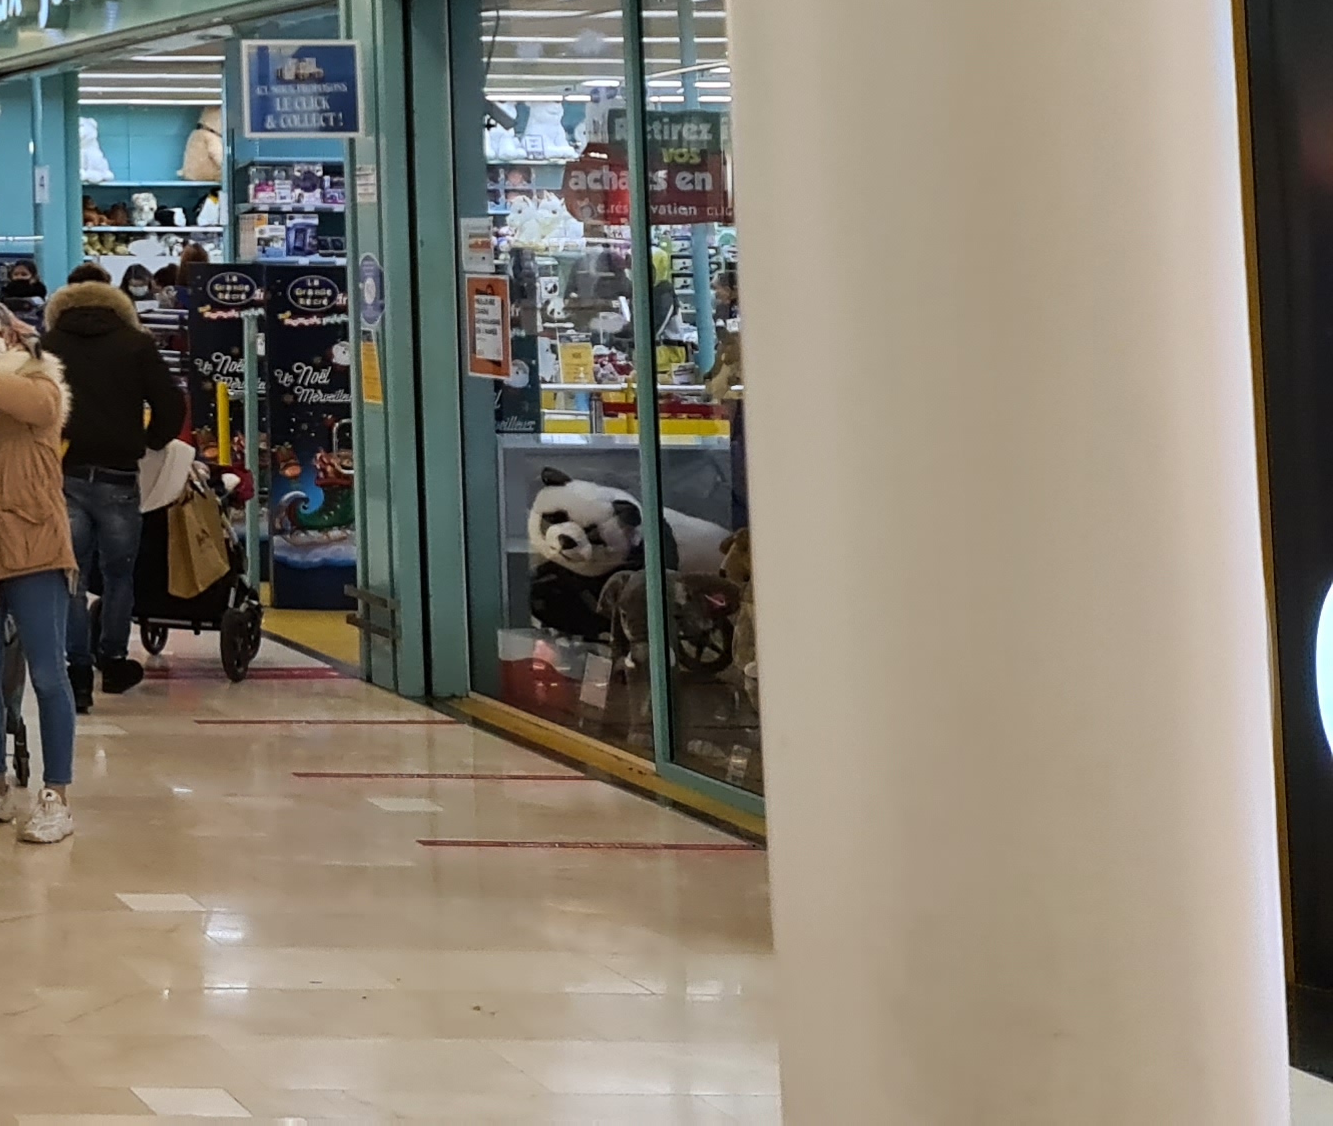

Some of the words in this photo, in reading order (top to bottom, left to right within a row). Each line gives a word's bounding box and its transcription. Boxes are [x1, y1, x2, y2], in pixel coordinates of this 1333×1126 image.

[661, 147, 702, 164] vos
[675, 170, 713, 191] en
[293, 362, 332, 386] Noël
